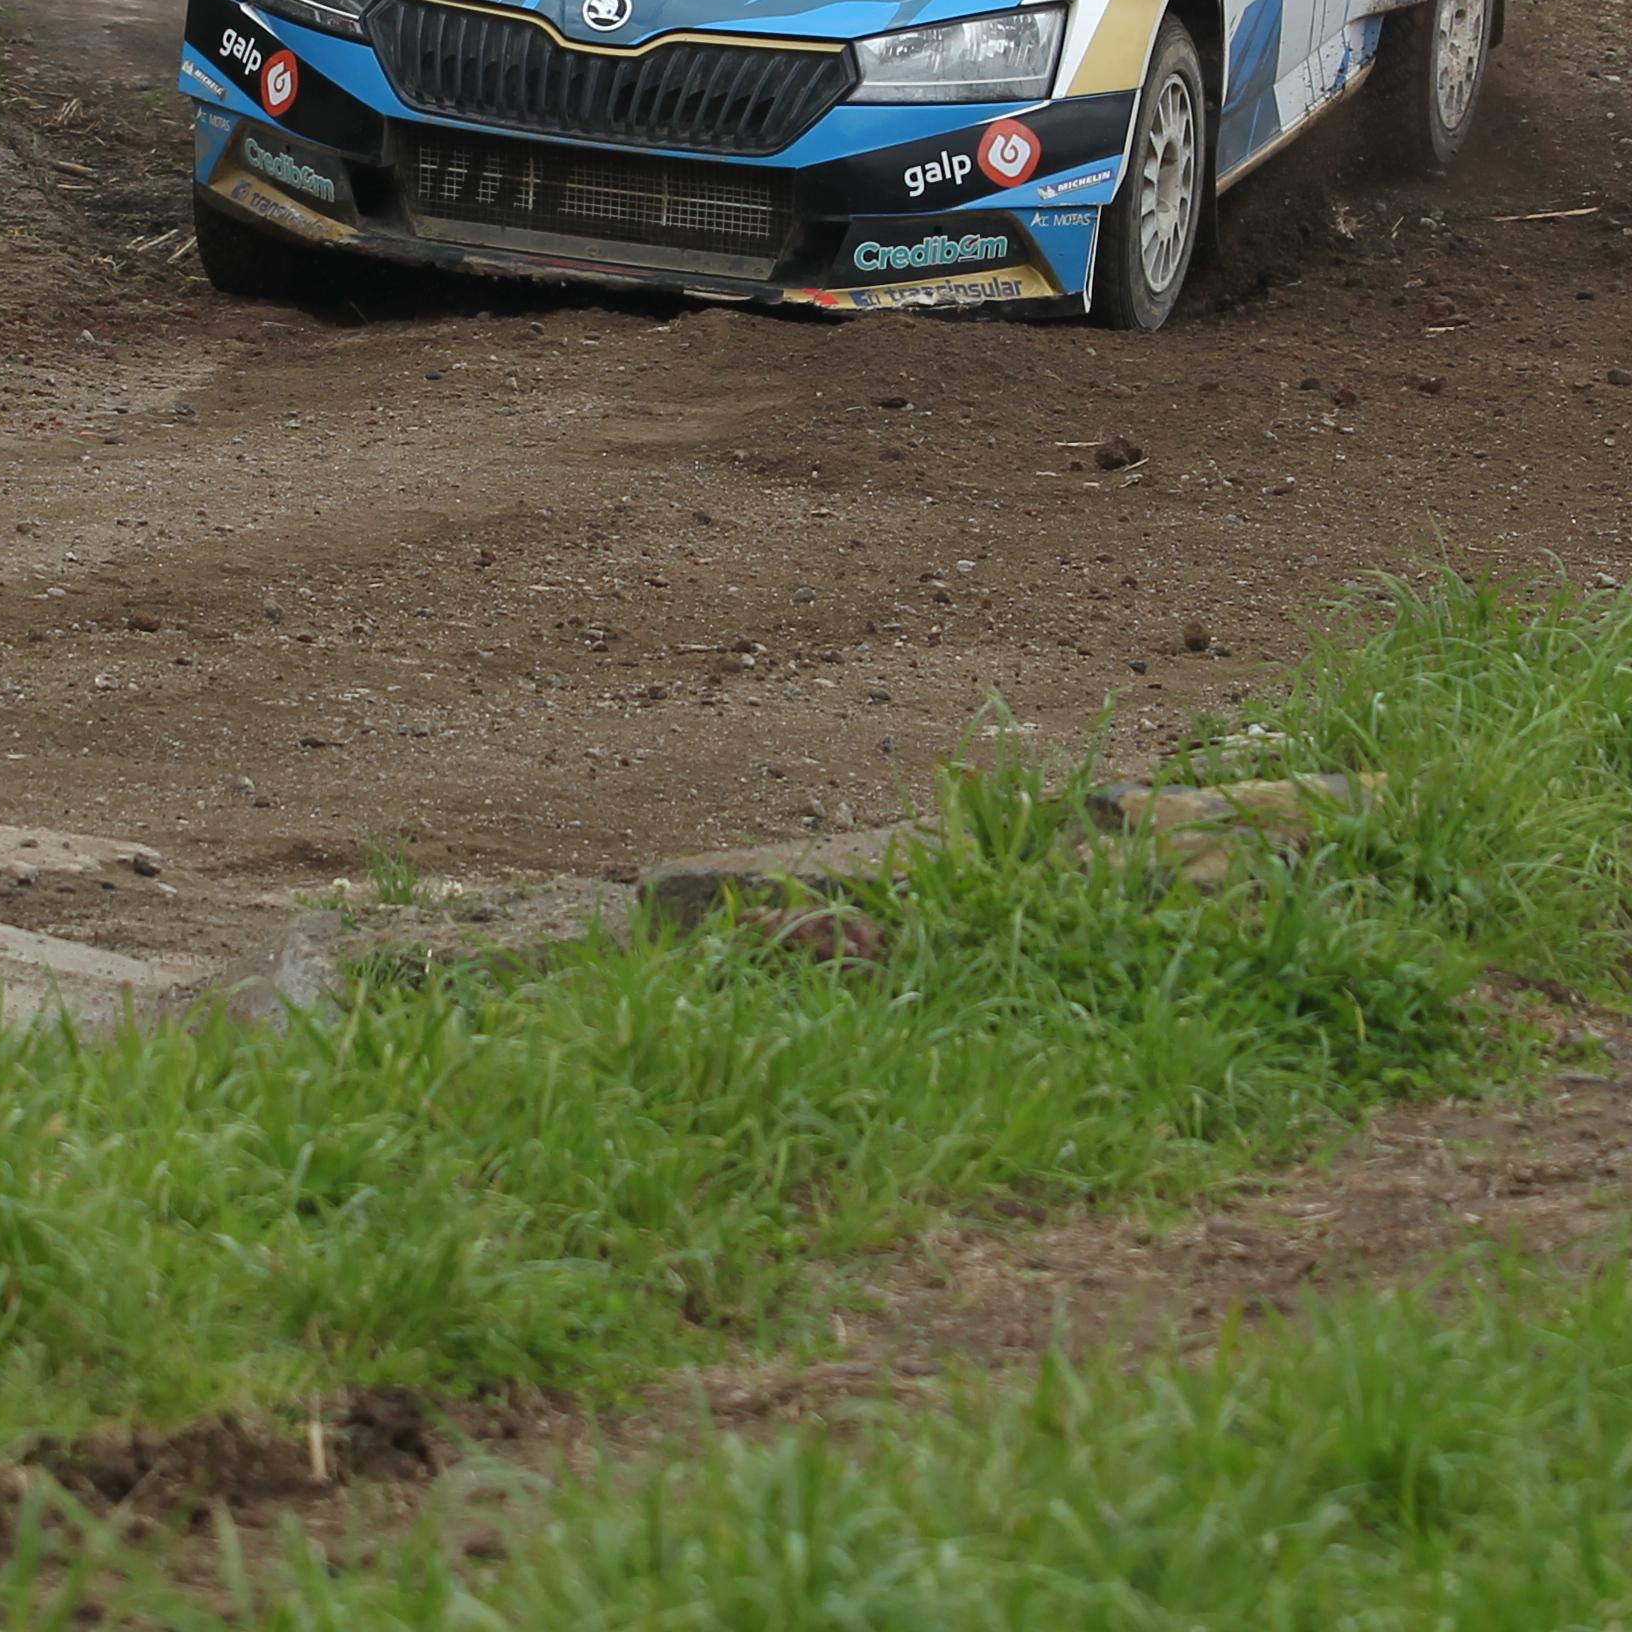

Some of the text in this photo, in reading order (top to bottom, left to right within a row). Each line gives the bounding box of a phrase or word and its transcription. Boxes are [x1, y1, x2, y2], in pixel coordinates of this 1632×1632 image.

[219, 28, 262, 75] galp
[244, 137, 335, 202] Credibom
[904, 150, 972, 197] galp
[1057, 170, 1112, 192] MICHELIN
[1053, 213, 1091, 226] MOTAS
[853, 234, 1008, 271] Credibom
